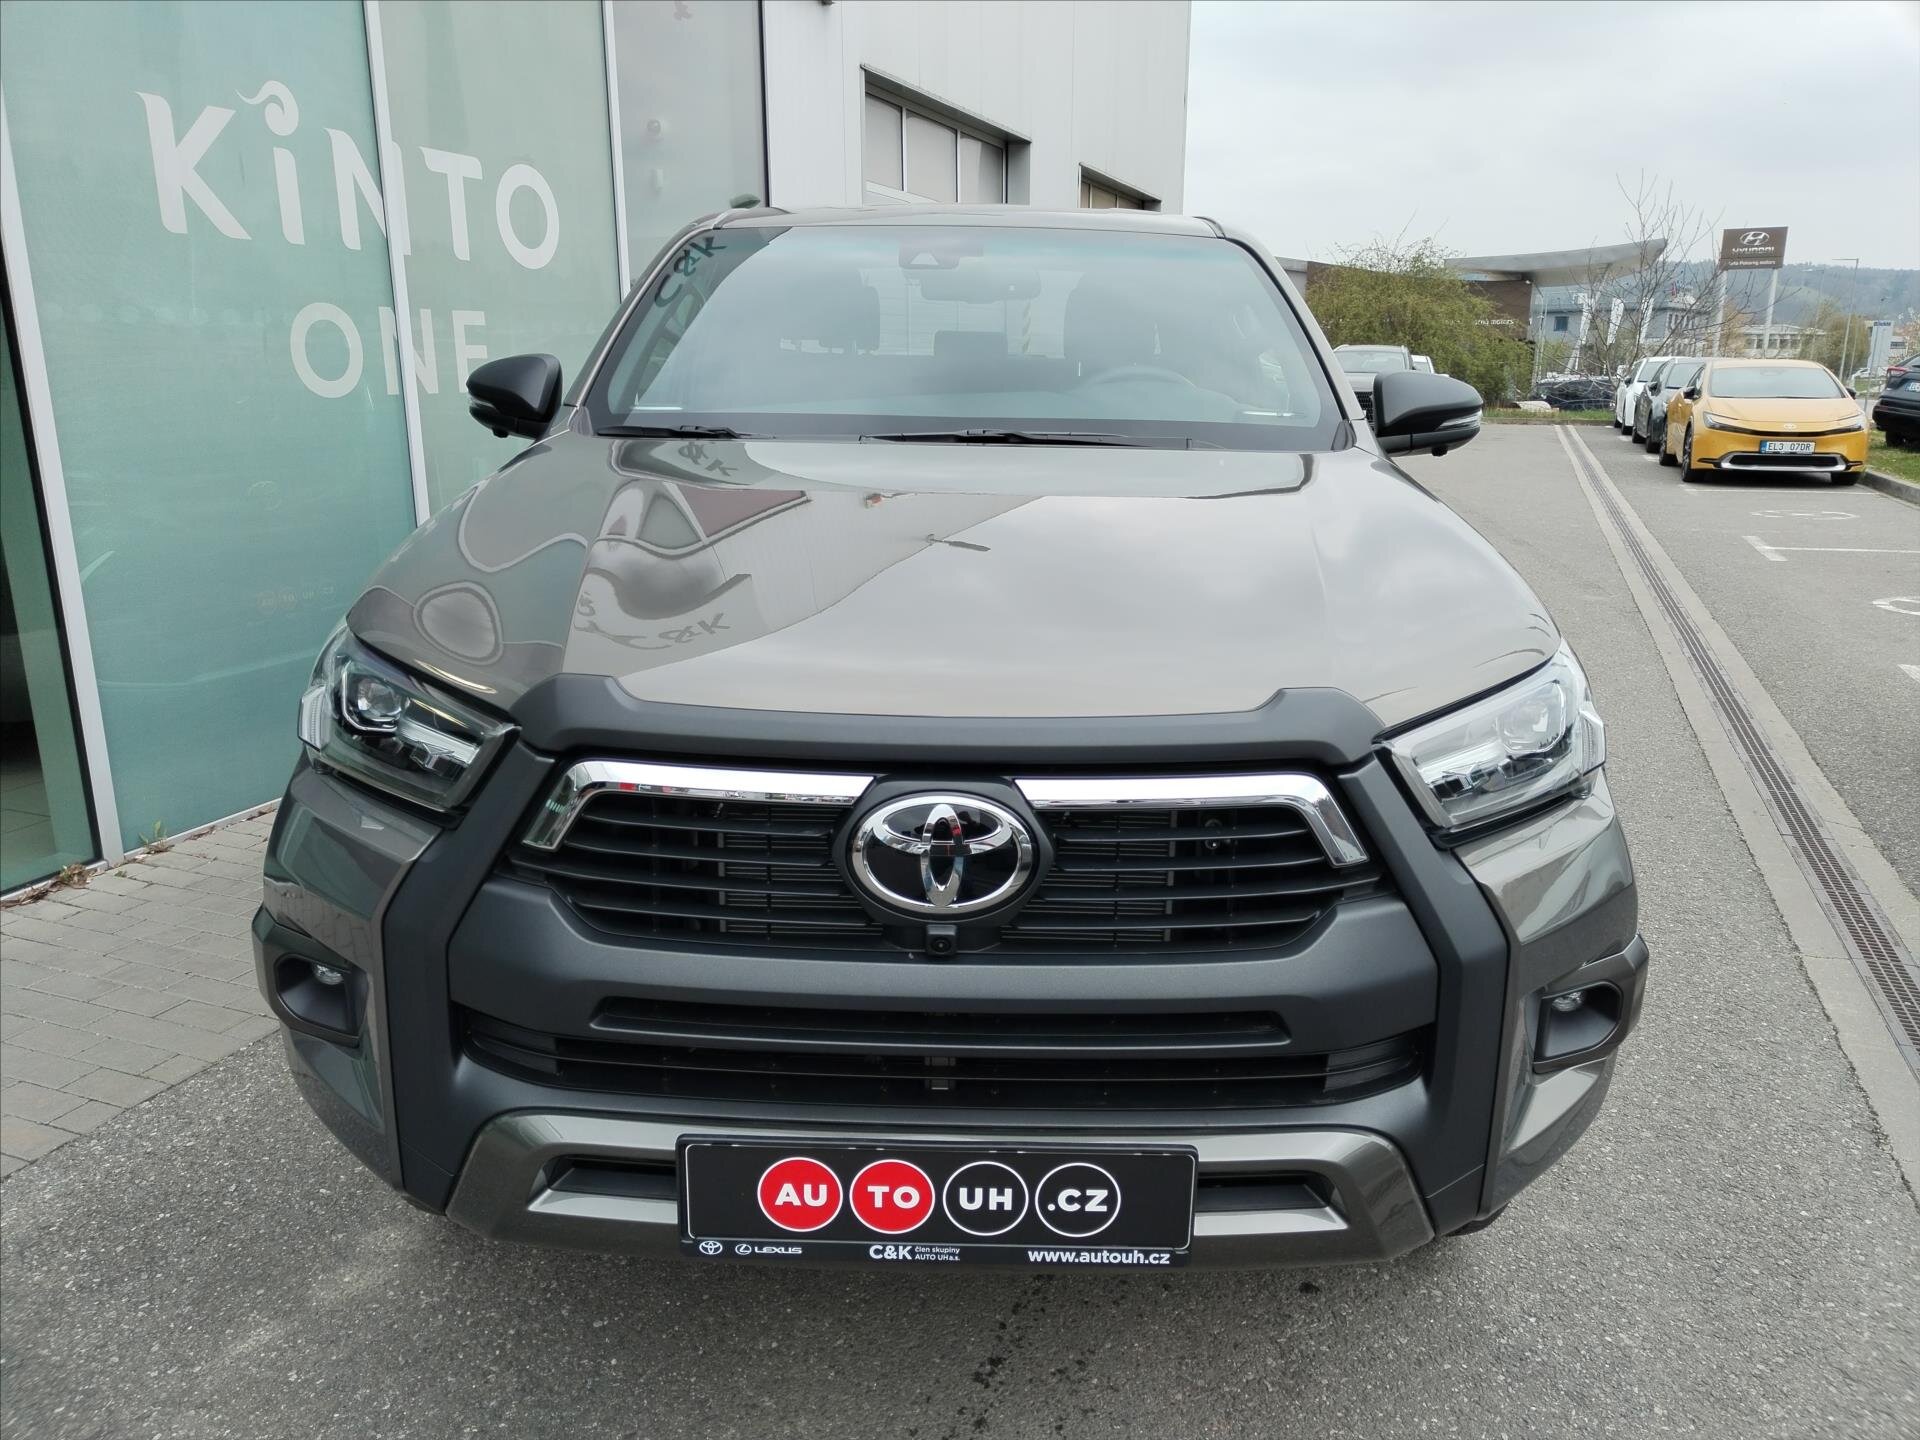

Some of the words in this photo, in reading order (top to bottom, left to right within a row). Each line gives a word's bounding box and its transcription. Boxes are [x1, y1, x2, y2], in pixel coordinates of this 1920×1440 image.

[754, 1246, 802, 1254] LEXUS
[869, 1244, 912, 1260] C&K
[931, 1246, 960, 1254] skupiny
[914, 1253, 936, 1261] AUTO
[1028, 1250, 1170, 1264] www.autouh.cz
